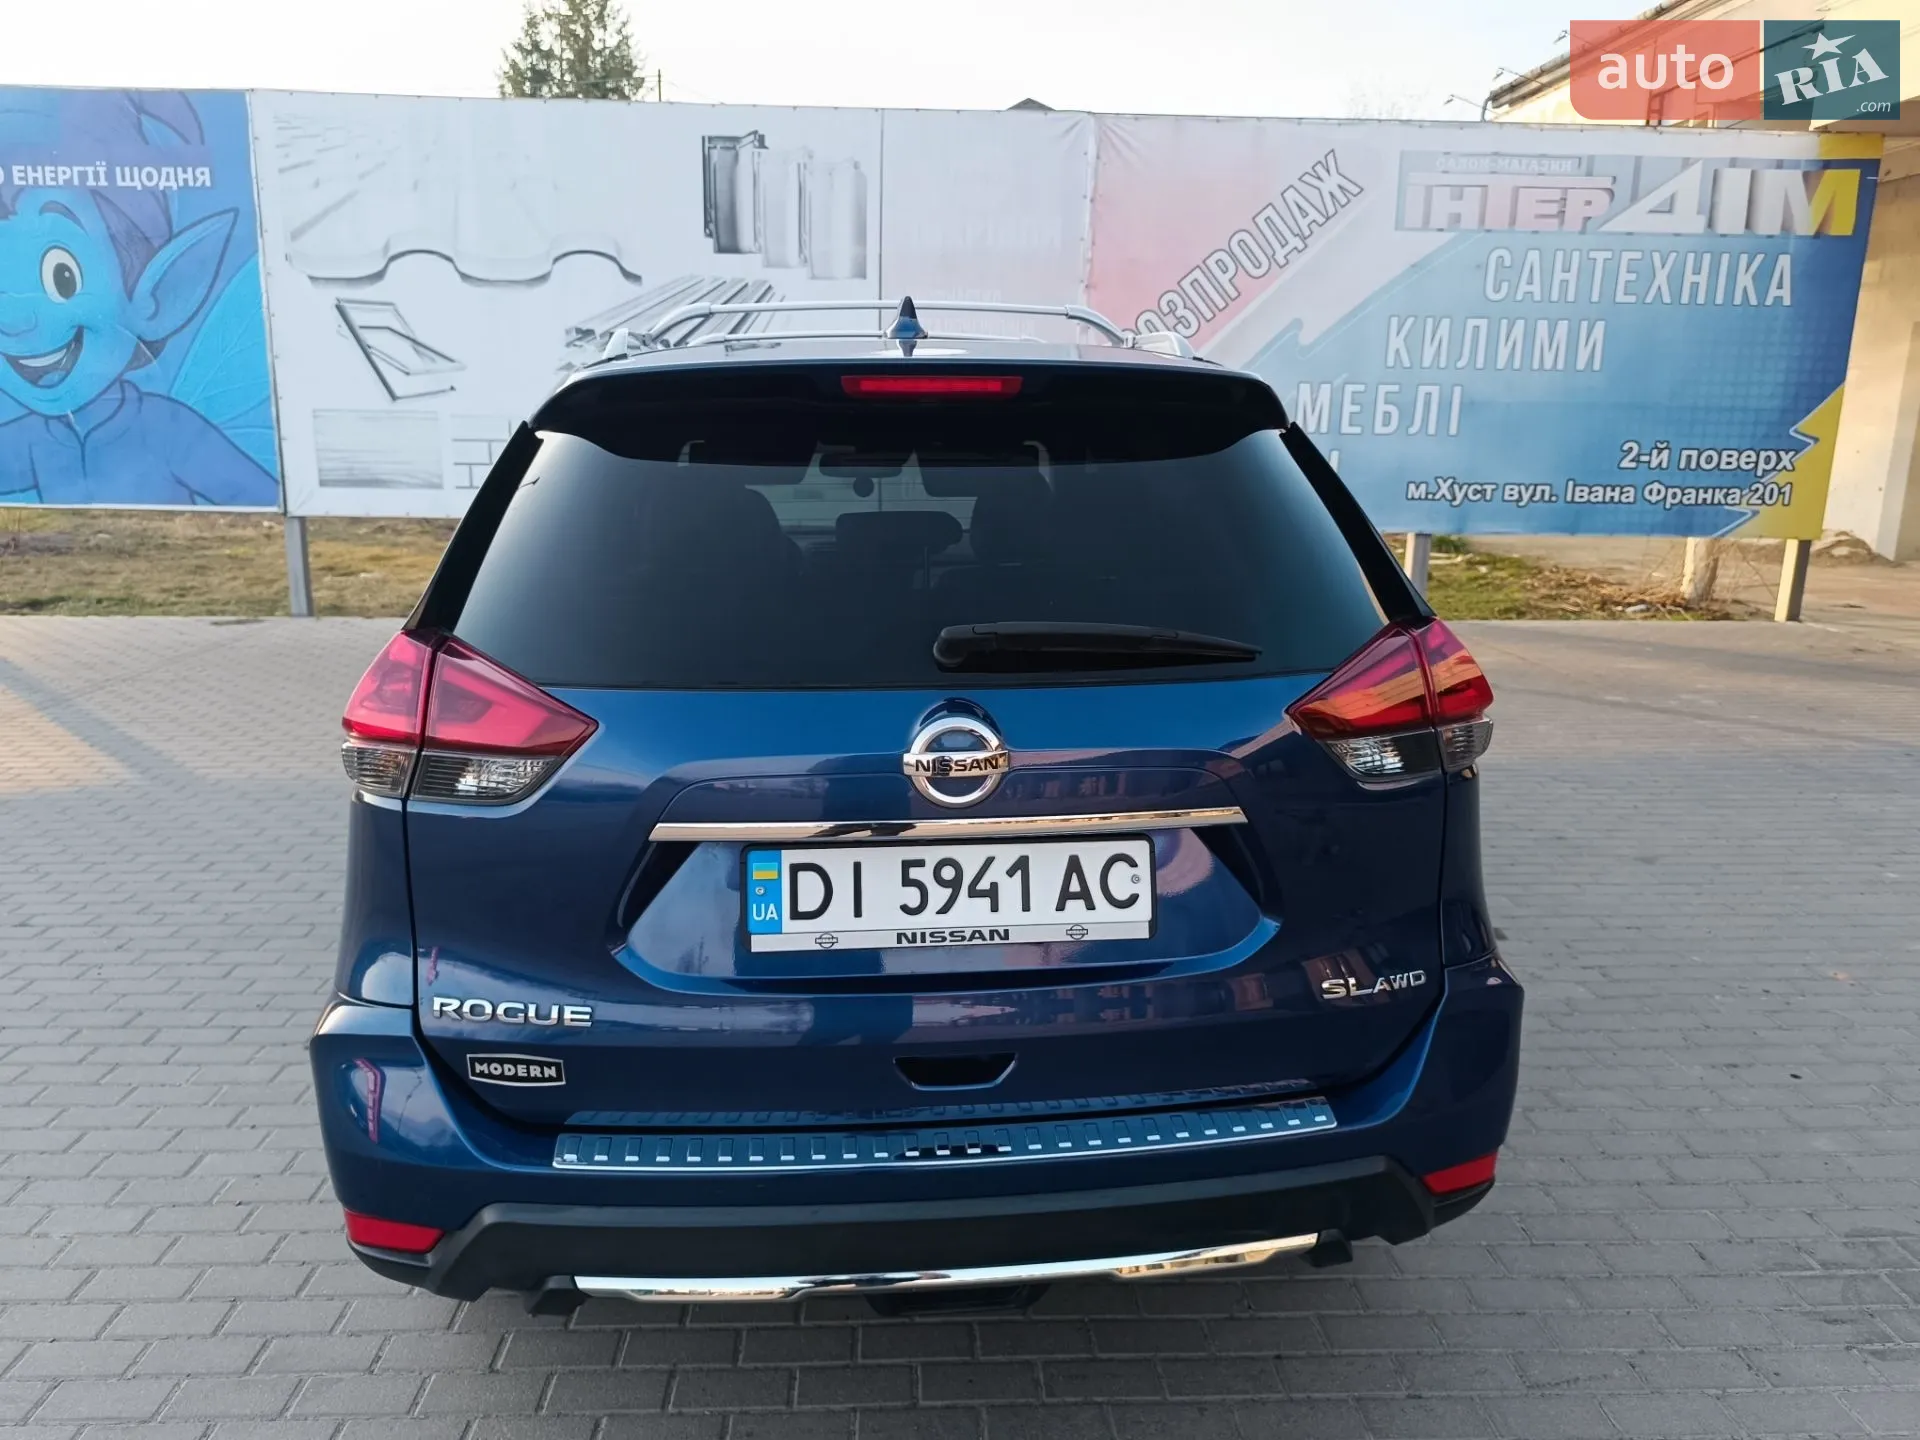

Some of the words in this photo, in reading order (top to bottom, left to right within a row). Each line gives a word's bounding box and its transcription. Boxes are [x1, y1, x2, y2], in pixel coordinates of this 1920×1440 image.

[11, 160, 109, 187] ЕНЕРГІЇ
[115, 165, 212, 190] ЩОДНЯ
[1121, 149, 1364, 339] ОЗПРОДАЖ
[1483, 247, 1793, 307] САНТЕХНІКА
[1384, 315, 1606, 372] КИЛИМИ
[1295, 381, 1464, 437] МЕБЛІ
[1618, 440, 1670, 471] 2-й
[1678, 448, 1797, 477] поверх
[1405, 476, 1498, 508] м.Хуст
[1503, 481, 1559, 508] вул.
[1564, 479, 1637, 504] Івана
[1642, 480, 1741, 511] Франка
[1746, 481, 1793, 507] 201
[915, 756, 1000, 774] NISSAN
[788, 861, 863, 921] DI
[899, 854, 1032, 916] 5941
[1055, 852, 1140, 911] AC
[752, 902, 780, 921] UA
[896, 927, 1010, 946] NISSAN
[1321, 977, 1374, 1000] SL
[1372, 969, 1427, 994] AWD
[432, 996, 593, 1028] ROGUE
[474, 1060, 558, 1080] MODERN
